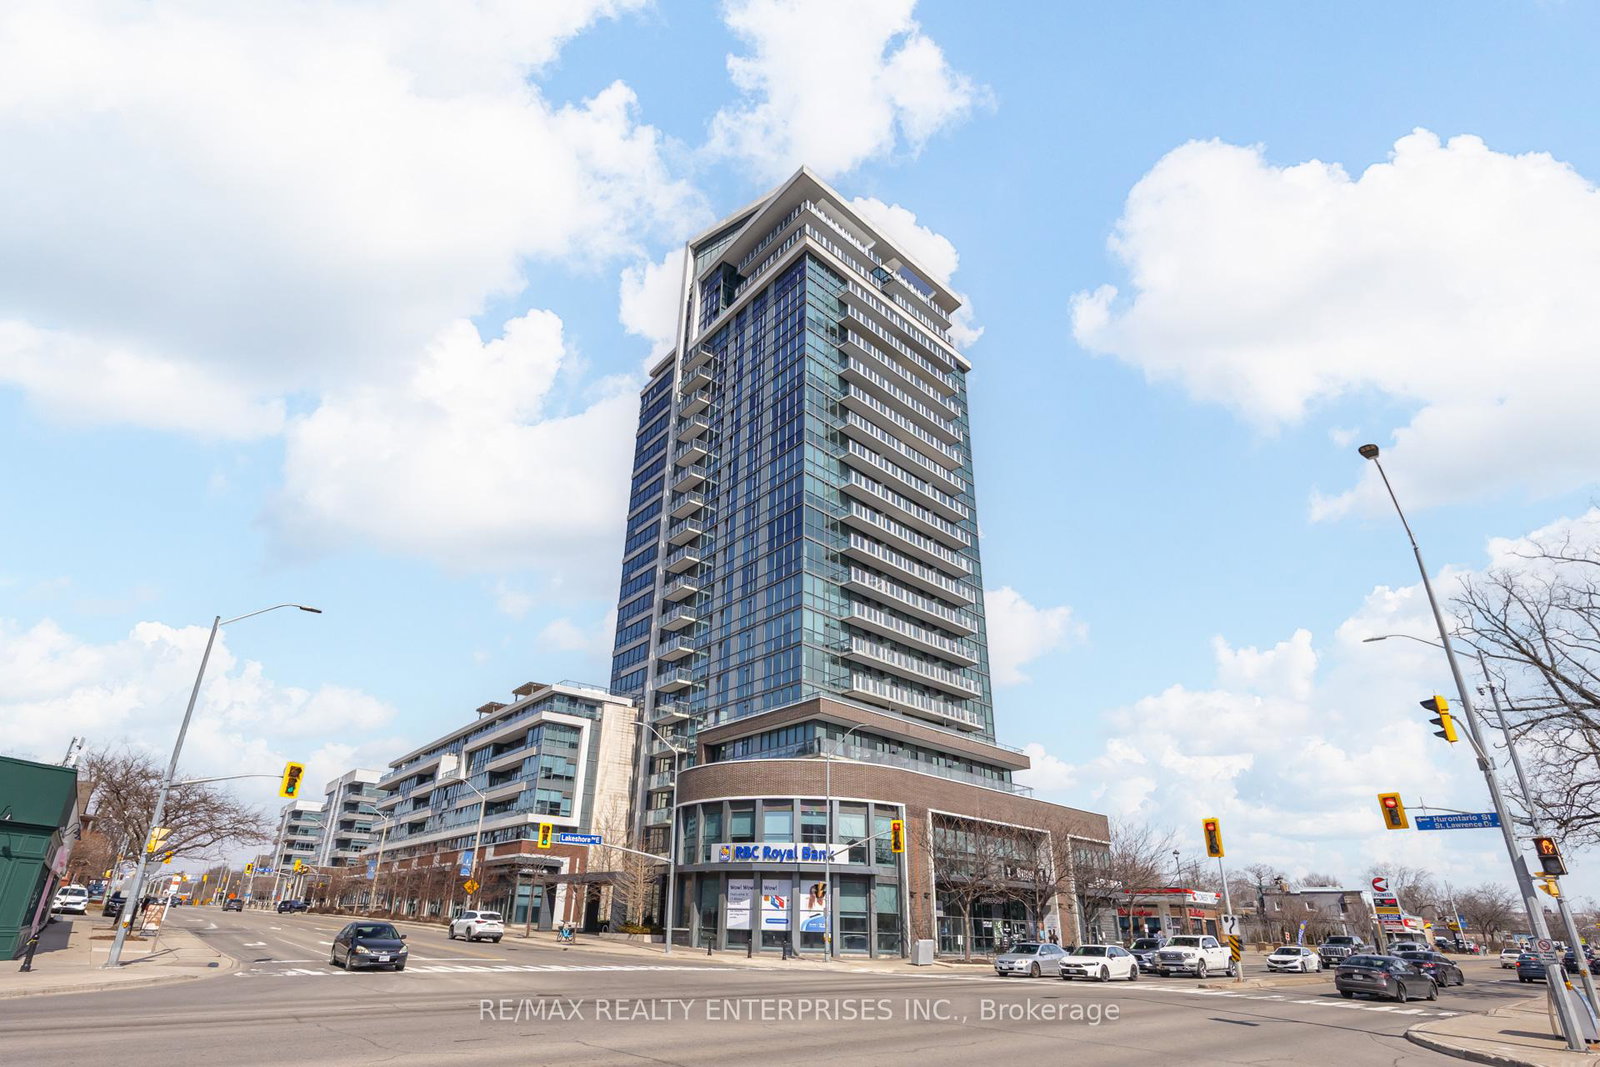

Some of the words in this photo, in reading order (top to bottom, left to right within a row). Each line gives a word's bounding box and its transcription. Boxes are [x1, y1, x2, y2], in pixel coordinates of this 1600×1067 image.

[1433, 815, 1478, 823] Hurontario
[561, 834, 591, 843] Lakeshore
[735, 846, 760, 860] RBC
[762, 846, 798, 862] Royal
